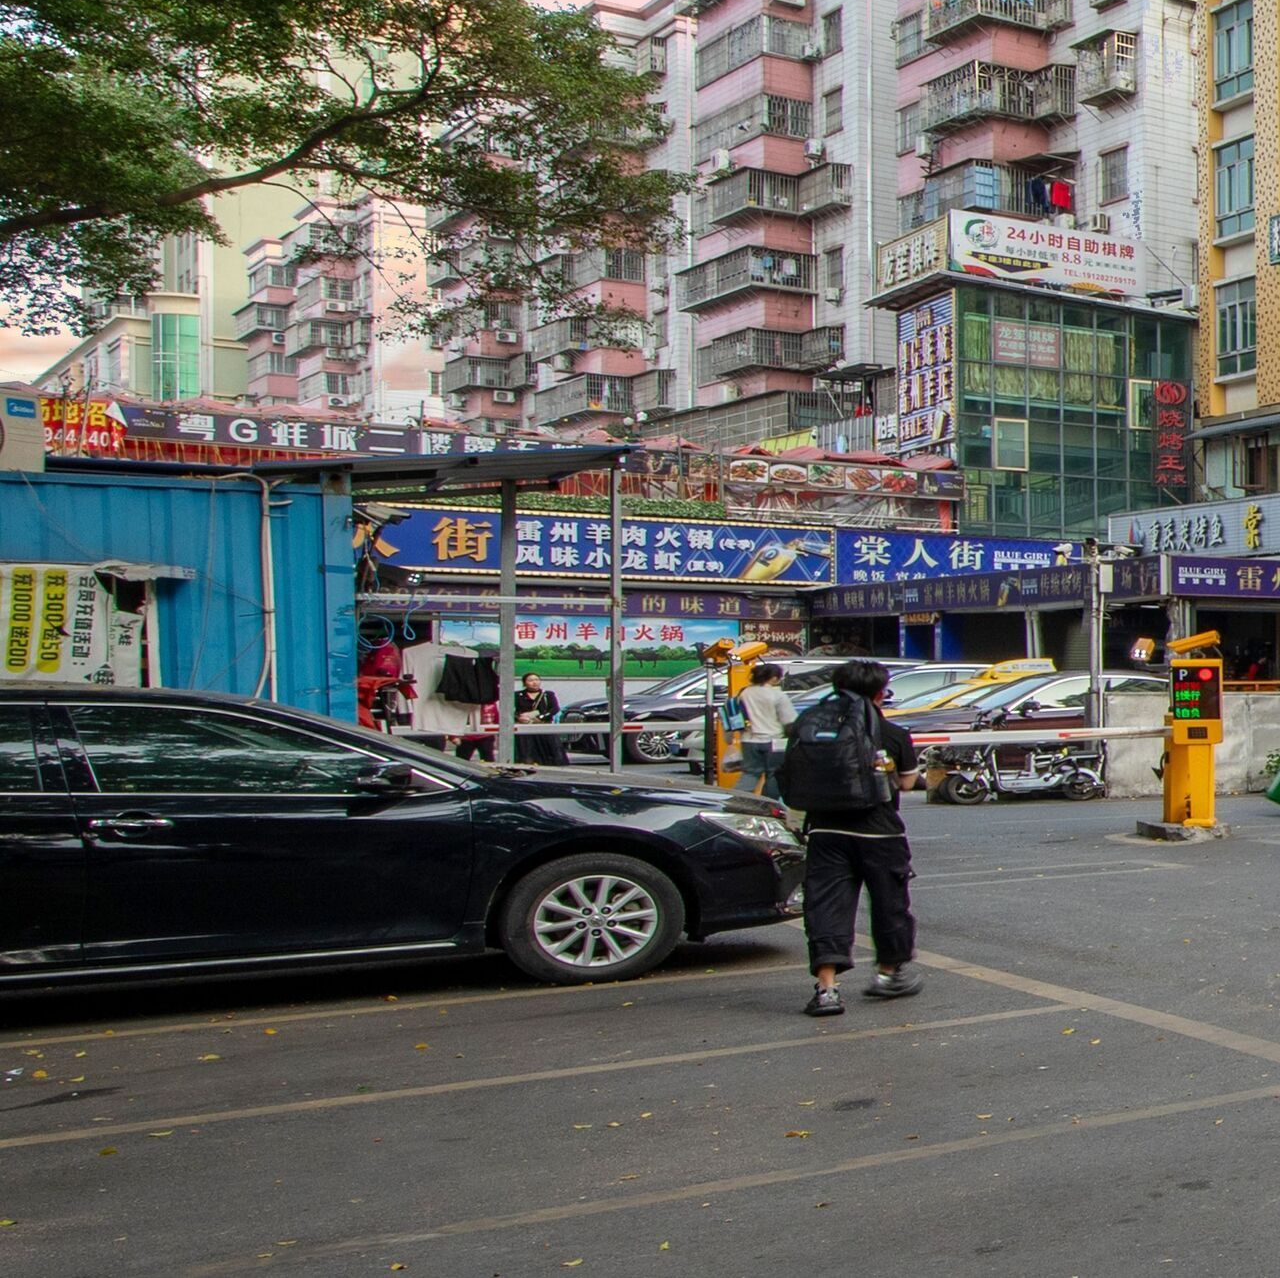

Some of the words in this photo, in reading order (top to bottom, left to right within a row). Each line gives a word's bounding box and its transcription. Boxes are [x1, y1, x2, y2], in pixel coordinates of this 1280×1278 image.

[1006, 225, 1135, 261] 24小时自助棋牌
[178, 413, 583, 453] 粤G蚝城二楼露
[1157, 409, 1186, 472] 烧烤王
[853, 535, 985, 572] 棠人街
[994, 550, 1021, 560] BLUE
[1178, 566, 1200, 576] BLUE
[1203, 567, 1226, 576] GIRL
[8, 573, 34, 667] 充1000送200
[1179, 668, 1189, 681] P
